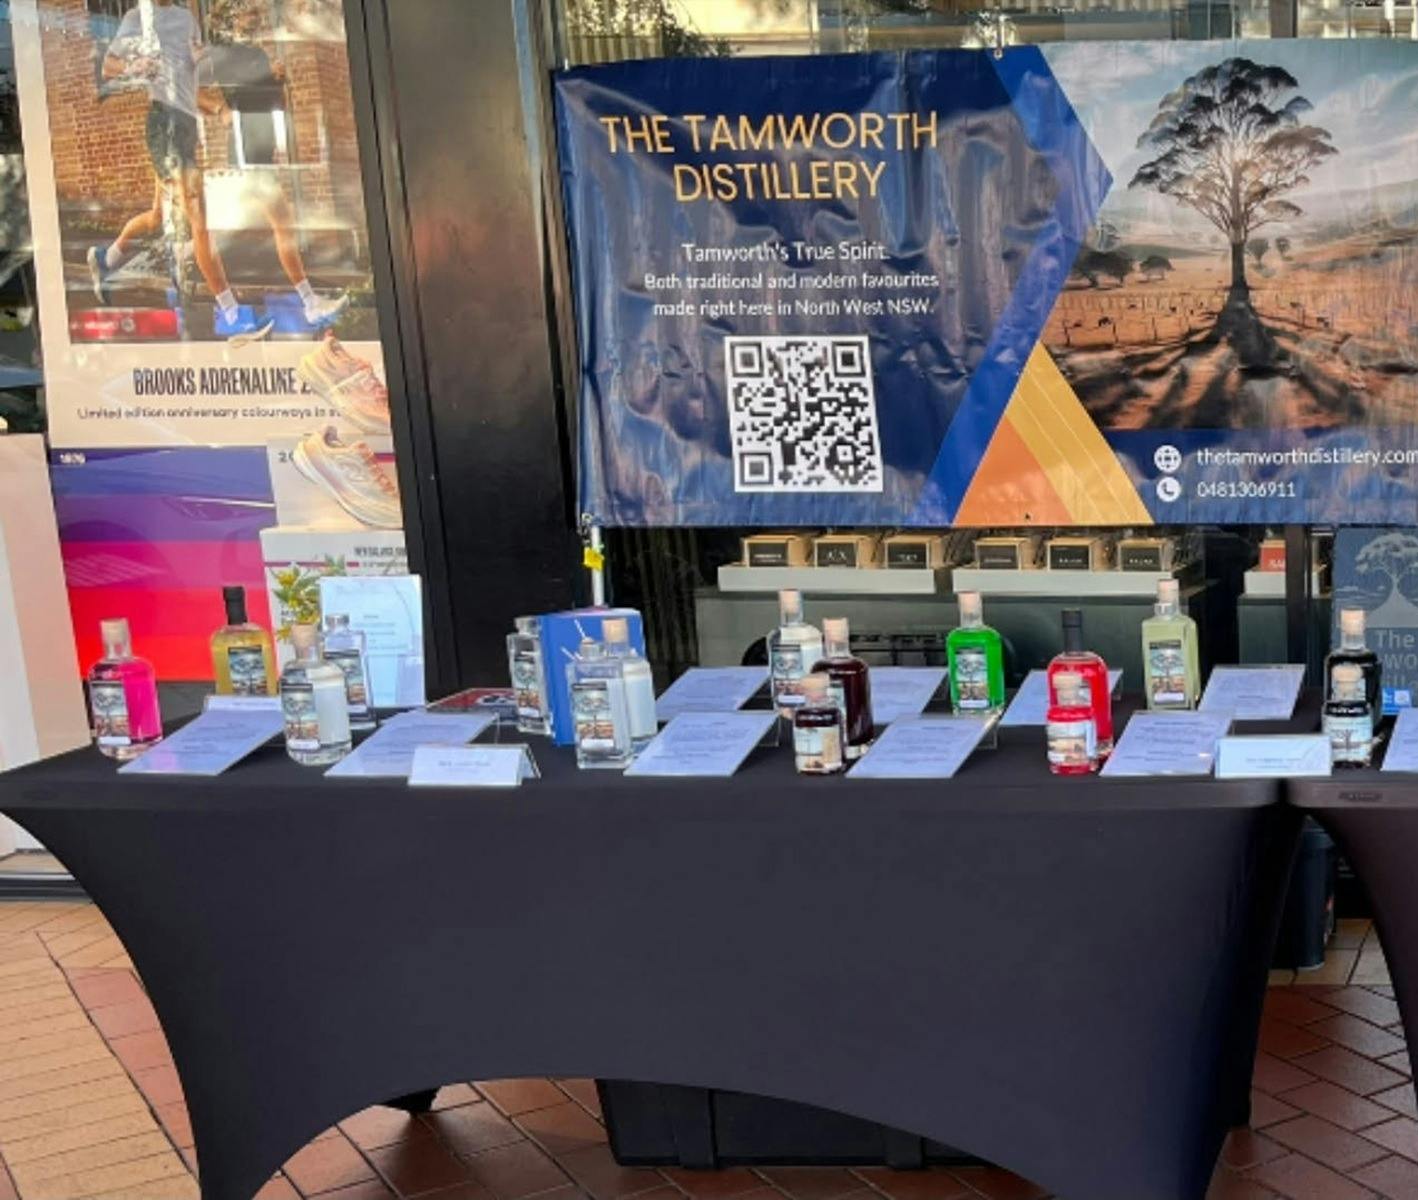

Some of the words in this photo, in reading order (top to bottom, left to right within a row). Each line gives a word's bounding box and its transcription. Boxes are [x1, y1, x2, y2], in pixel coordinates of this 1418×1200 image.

[600, 114, 675, 153] THE
[684, 111, 938, 151] TAMWORTH
[673, 161, 887, 201] DISTILLERY
[682, 242, 789, 262] Tamworth's
[793, 243, 835, 261] True
[644, 273, 681, 289] Both
[686, 272, 762, 289] traditional
[767, 273, 795, 289] and
[799, 273, 857, 288] modern
[861, 271, 939, 287] favourites
[653, 300, 696, 316] made
[700, 300, 736, 321] right
[739, 300, 773, 316] here
[777, 300, 792, 316] in
[795, 299, 840, 316] North
[843, 299, 884, 315] West
[887, 299, 935, 315] NSW.
[133, 368, 196, 396] BROOKS
[200, 367, 297, 395] ADRENALINE
[77, 407, 122, 419] Limited
[125, 408, 165, 419] edition
[167, 408, 238, 421] anniversary
[242, 407, 311, 419] colourways
[315, 406, 326, 418] in
[1197, 480, 1296, 498] 0481306911
[1375, 630, 1416, 648] The
